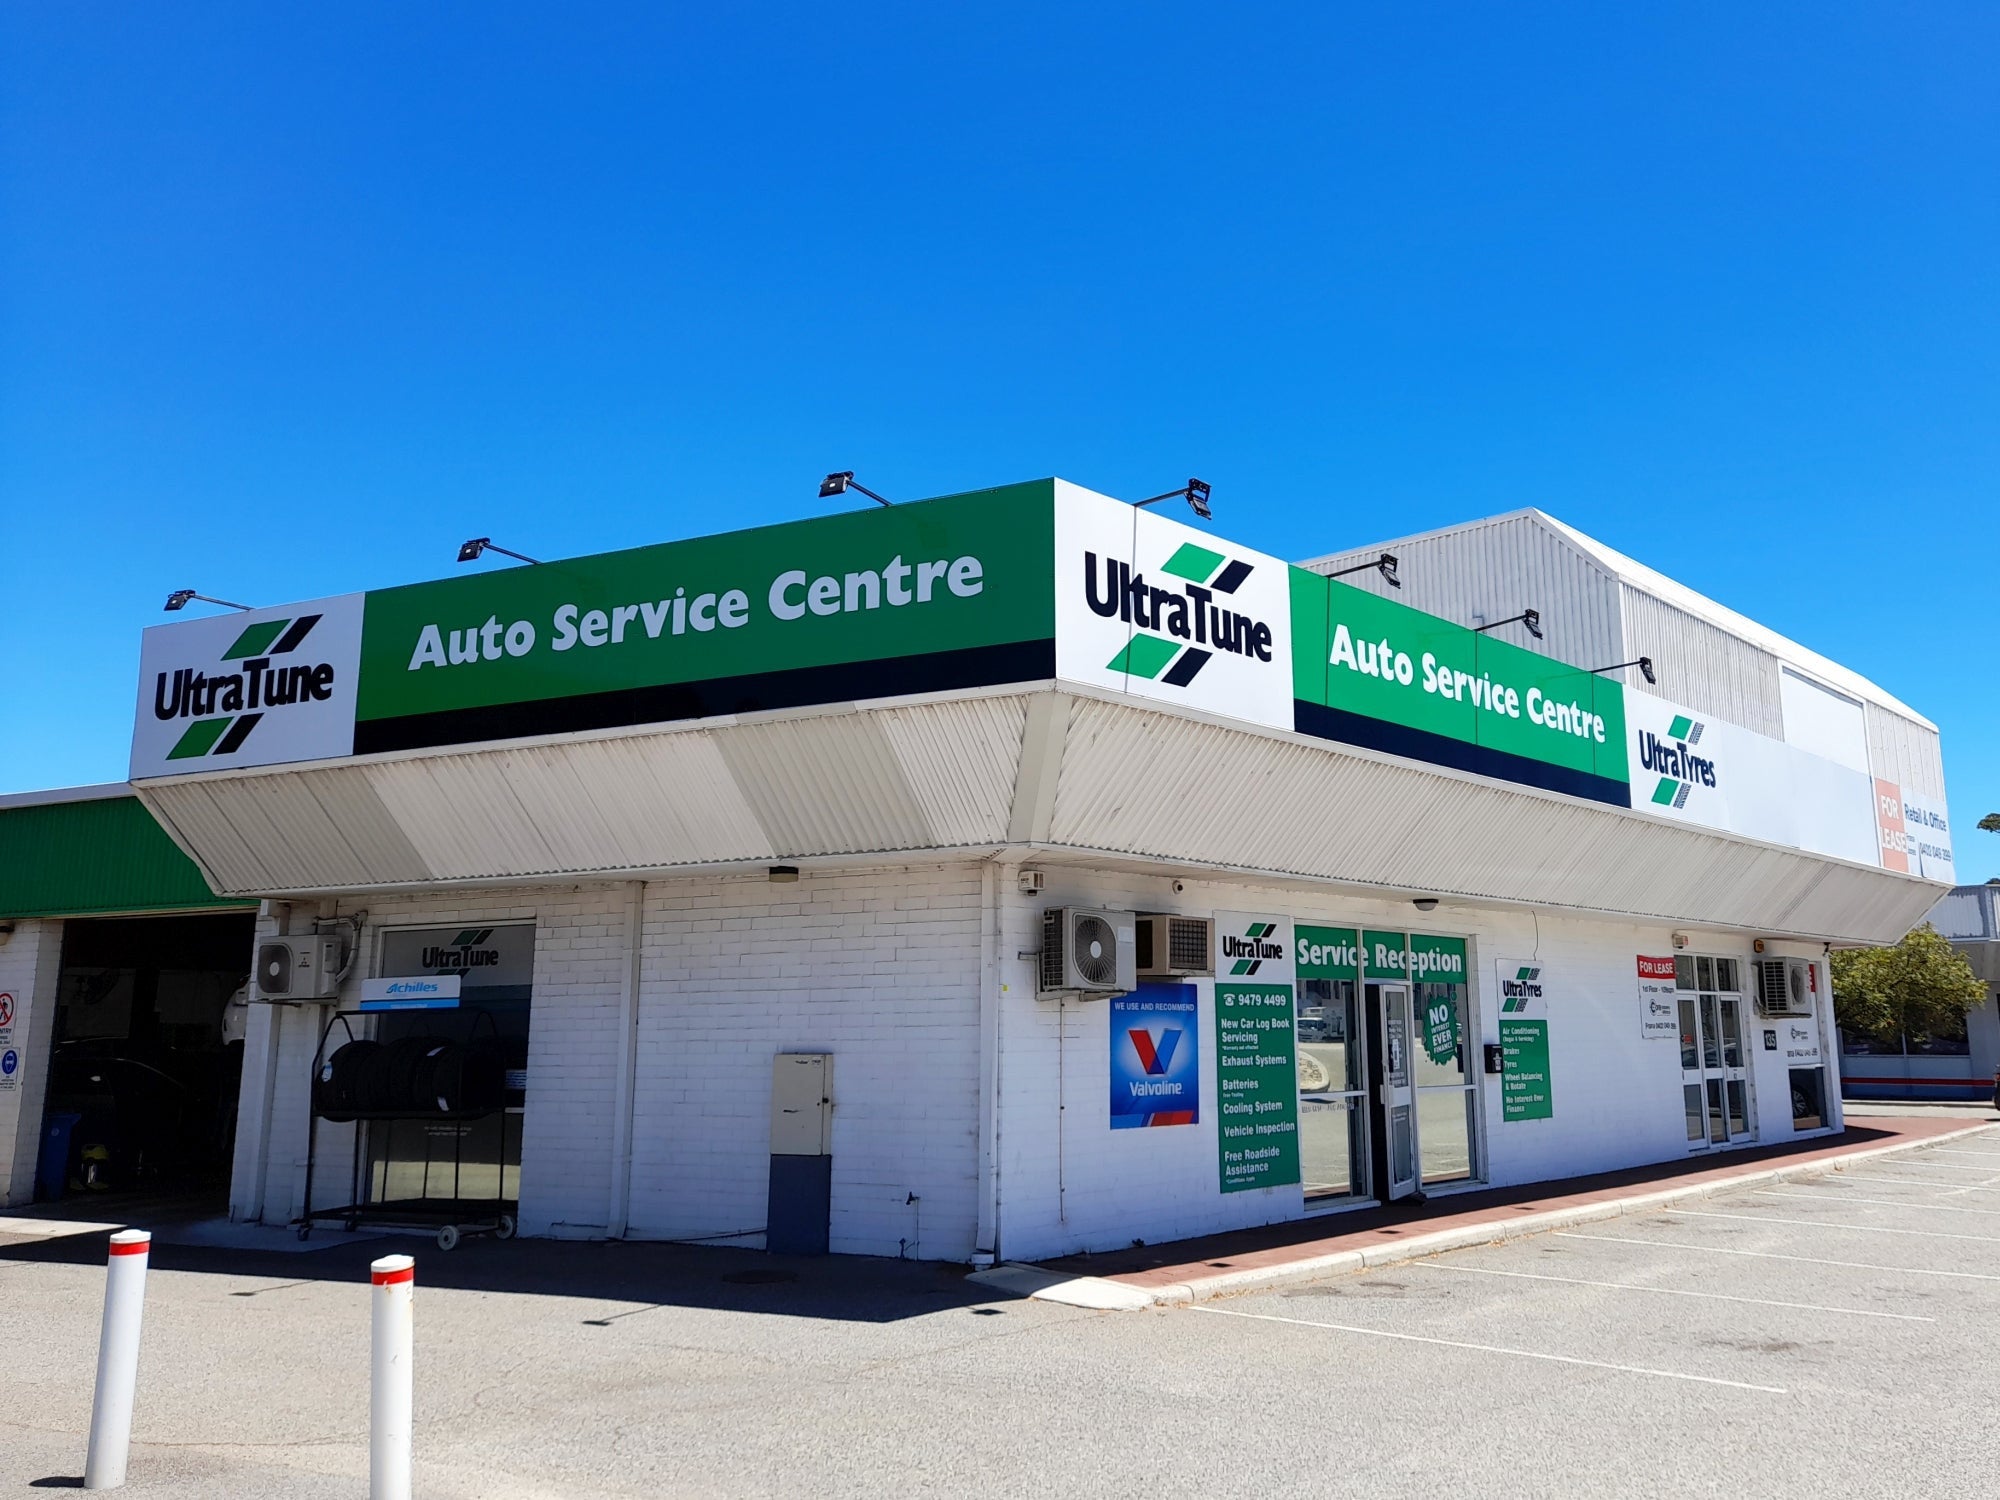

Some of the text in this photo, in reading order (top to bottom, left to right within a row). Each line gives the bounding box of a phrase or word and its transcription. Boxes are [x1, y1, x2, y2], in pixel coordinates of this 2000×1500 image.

[408, 554, 984, 671] Auto Service Centre
[1084, 550, 1272, 662] UltraTune
[154, 657, 334, 721] UltraTune
[1329, 624, 1605, 743] Auto Service Centre
[1638, 729, 1716, 788] UltraTyres
[1880, 795, 1899, 819] FOR
[1904, 803, 1922, 824] Retail
[1929, 811, 1947, 832] Office
[1880, 826, 1907, 853] LEASE
[1222, 935, 1283, 960] UltraTune
[422, 946, 499, 968] UltraTune
[1297, 938, 1462, 978] Service Reception
[1640, 961, 1673, 974] FOR LEASE
[386, 982, 438, 994] Achilles
[1503, 980, 1542, 998] UltraTyres
[1115, 1002, 1195, 1011] WE USE AND RECOMMEND
[1238, 994, 1286, 1006] 9479 4499
[1429, 1004, 1449, 1026] NO
[1221, 1018, 1290, 1031] New Car Log Book
[1431, 1022, 1450, 1034] INTEREST
[1511, 1027, 1540, 1036] Conditioning
[1222, 1032, 1258, 1044] Servicing
[1432, 1031, 1452, 1047] EVER
[1765, 1034, 1776, 1047] 135
[1434, 1040, 1453, 1053] FINANCE
[1504, 1047, 1520, 1055] Brakes
[1222, 1055, 1286, 1067] Exhaust Systems
[1504, 1061, 1517, 1069] Tyres
[1223, 1079, 1259, 1090] Batteries
[1505, 1073, 1543, 1082] Wheel Balancing
[1130, 1081, 1182, 1096] Valvoline
[1505, 1081, 1526, 1090] & Rotate
[1506, 1094, 1544, 1104] No Interest Ever
[1223, 1101, 1282, 1115] Cooling System
[1507, 1105, 1525, 1113] Finance
[1224, 1121, 1295, 1138] Vehicle Inspection
[1225, 1146, 1280, 1162] Free Roadside
[1226, 1162, 1269, 1176] Assistance
